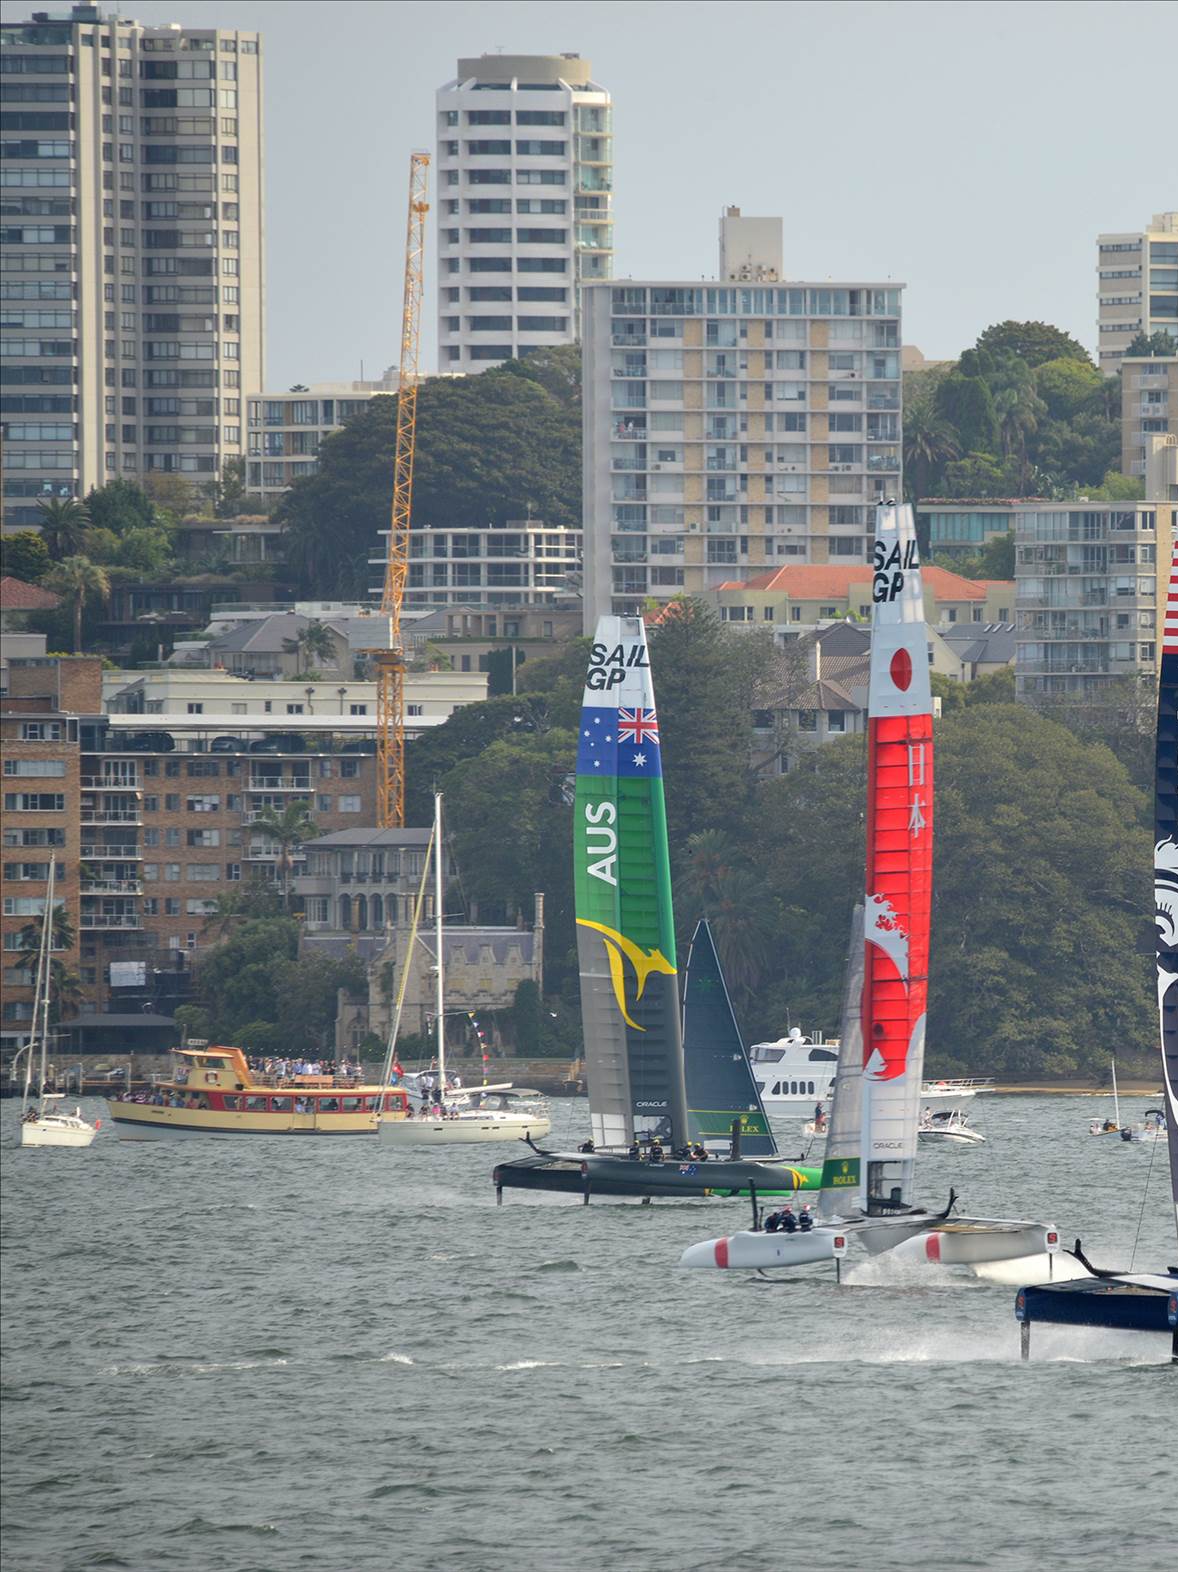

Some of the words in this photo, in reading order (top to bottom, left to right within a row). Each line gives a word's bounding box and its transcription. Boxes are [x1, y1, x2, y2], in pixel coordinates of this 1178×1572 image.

[873, 540, 919, 571] SAIL
[873, 571, 904, 603] GP
[590, 643, 650, 668] SAIL
[586, 668, 626, 691] GP
[585, 801, 617, 887] AUS
[730, 1125, 759, 1133] LEX
